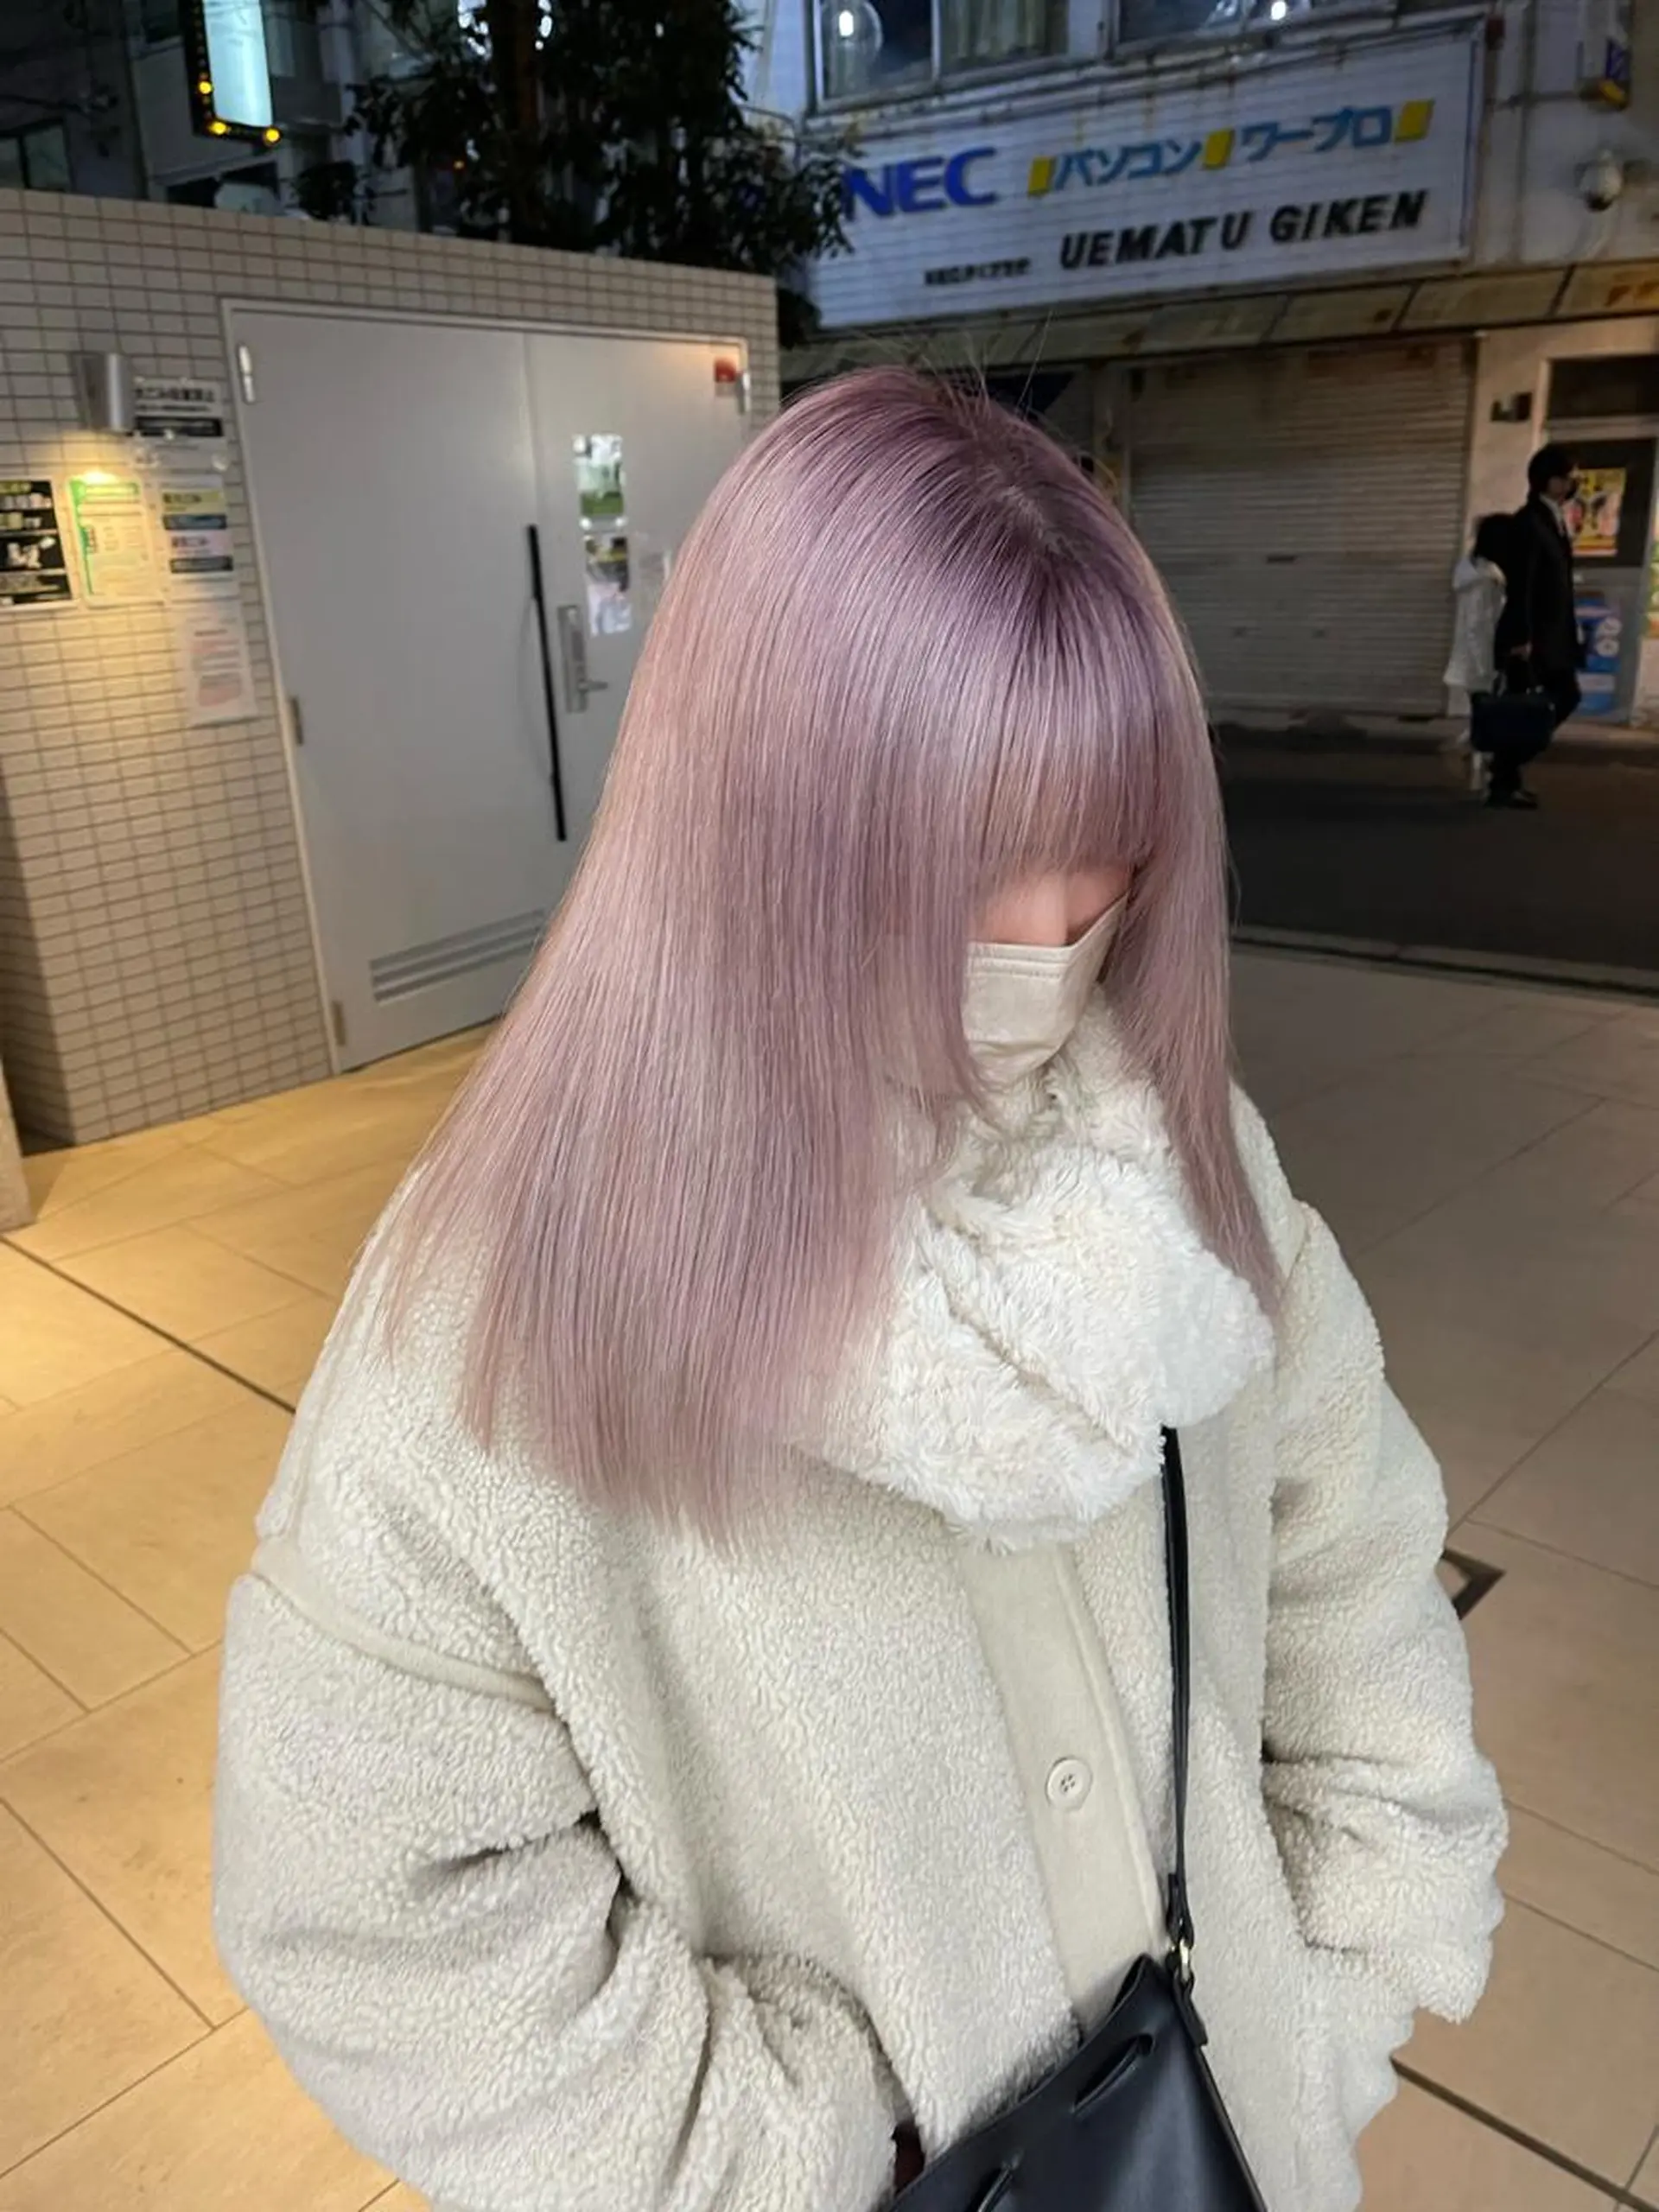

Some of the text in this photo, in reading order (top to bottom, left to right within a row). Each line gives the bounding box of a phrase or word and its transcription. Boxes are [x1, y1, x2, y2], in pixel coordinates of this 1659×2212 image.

[842, 146, 998, 222] NEC
[1055, 105, 1393, 191] パソコン ワープロ
[1060, 189, 1429, 270] UEMATU GIKEN
